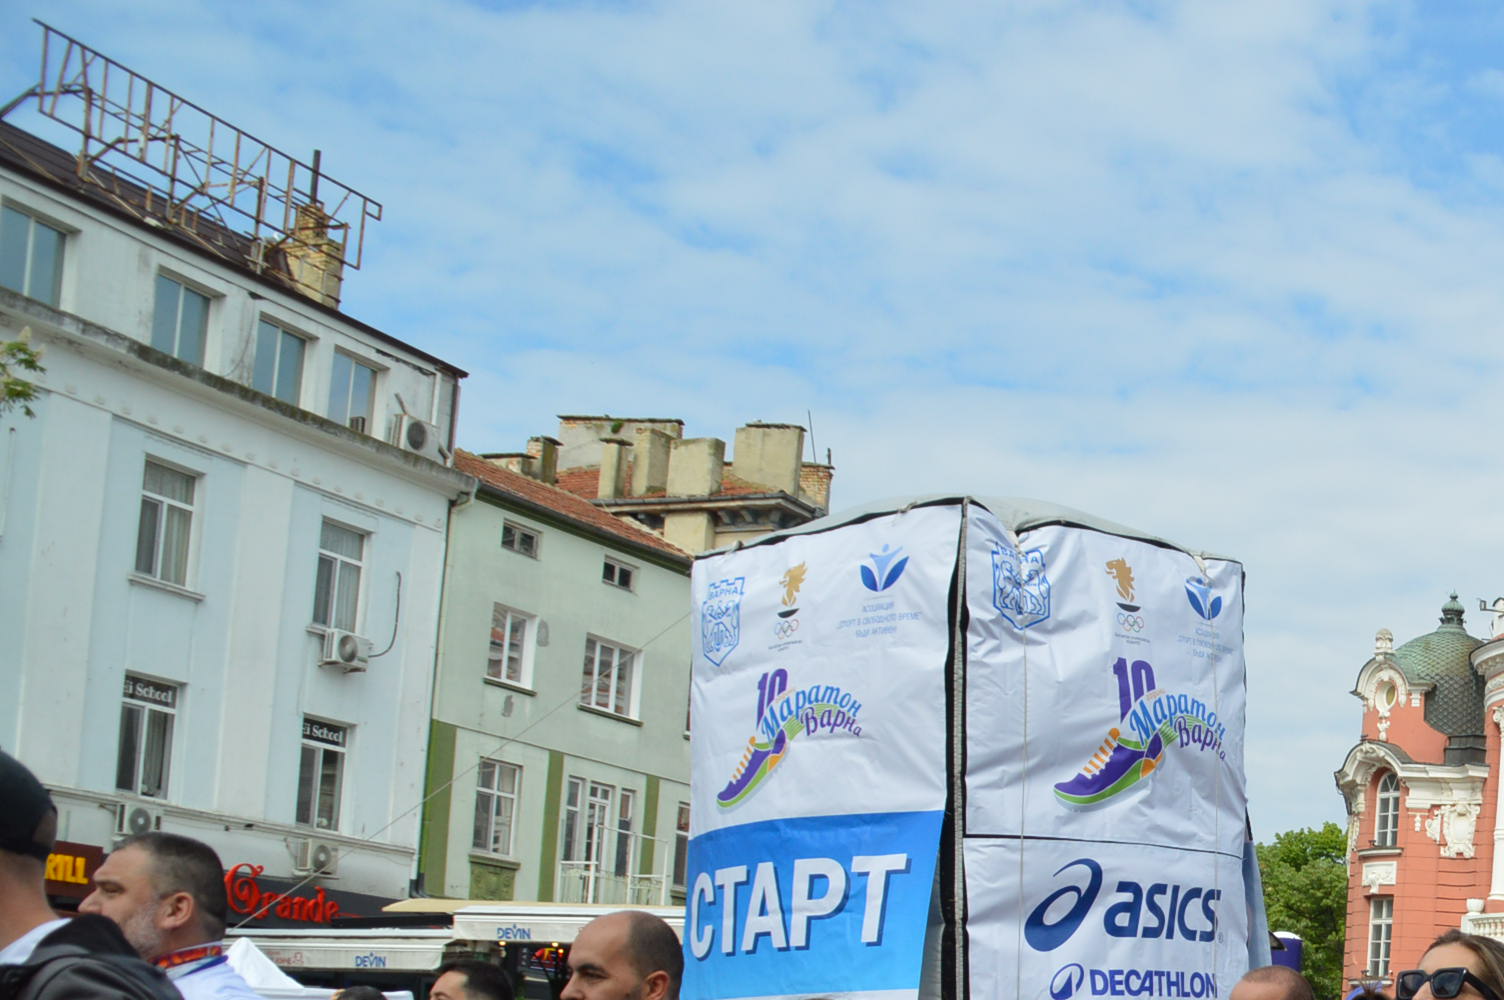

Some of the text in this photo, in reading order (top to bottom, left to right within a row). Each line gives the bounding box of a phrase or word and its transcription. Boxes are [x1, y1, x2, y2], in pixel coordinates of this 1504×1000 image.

[756, 668, 788, 730] 10
[761, 685, 862, 742] Маратон
[1113, 657, 1156, 724] 10
[800, 706, 862, 737] Варна
[1129, 693, 1226, 747] Маратон
[45, 853, 89, 885] RILL
[224, 863, 364, 924] Grande
[497, 925, 531, 939] DEVIN
[690, 853, 911, 961] СТАРТ
[355, 954, 387, 968] DEVIN
[1089, 968, 1218, 998] DECATHLON
